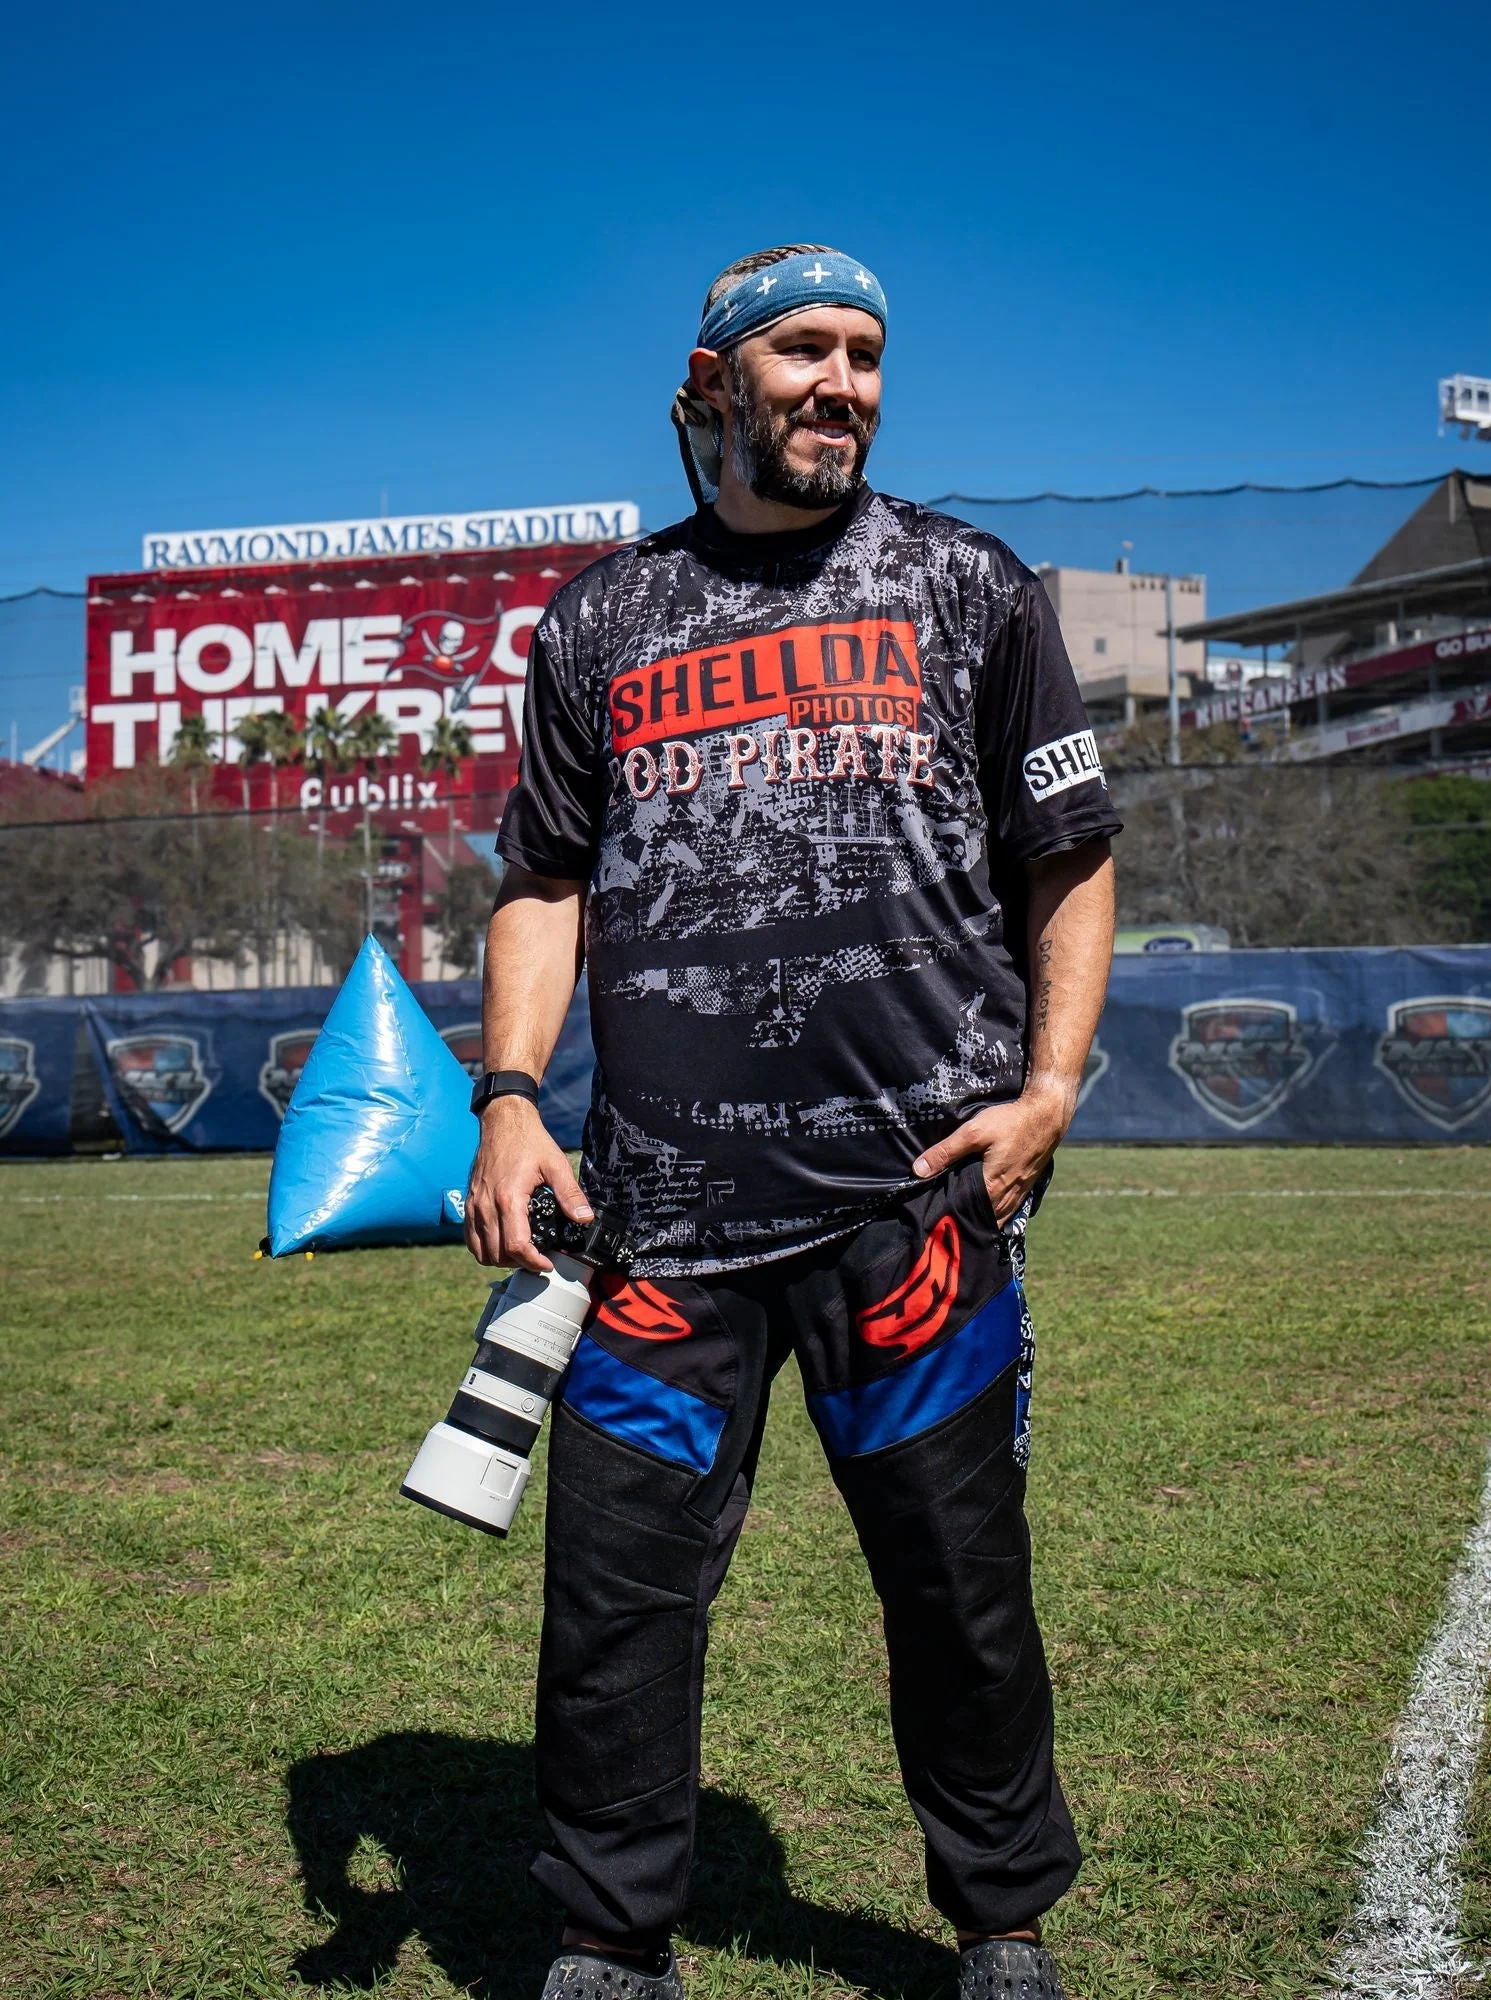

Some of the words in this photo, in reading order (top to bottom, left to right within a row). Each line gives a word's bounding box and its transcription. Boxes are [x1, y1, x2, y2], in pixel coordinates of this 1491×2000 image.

[150, 530, 329, 569] RAYMOND
[337, 520, 453, 556] JAMES
[464, 509, 624, 548] STADIUM
[110, 615, 402, 697] HOME
[306, 682, 526, 760] KRE
[791, 697, 914, 728] PHOTOS
[724, 724, 938, 789] PIRATE
[301, 772, 438, 813] Publix
[1040, 940, 1052, 964] DO
[1037, 980, 1052, 1032] MORE
